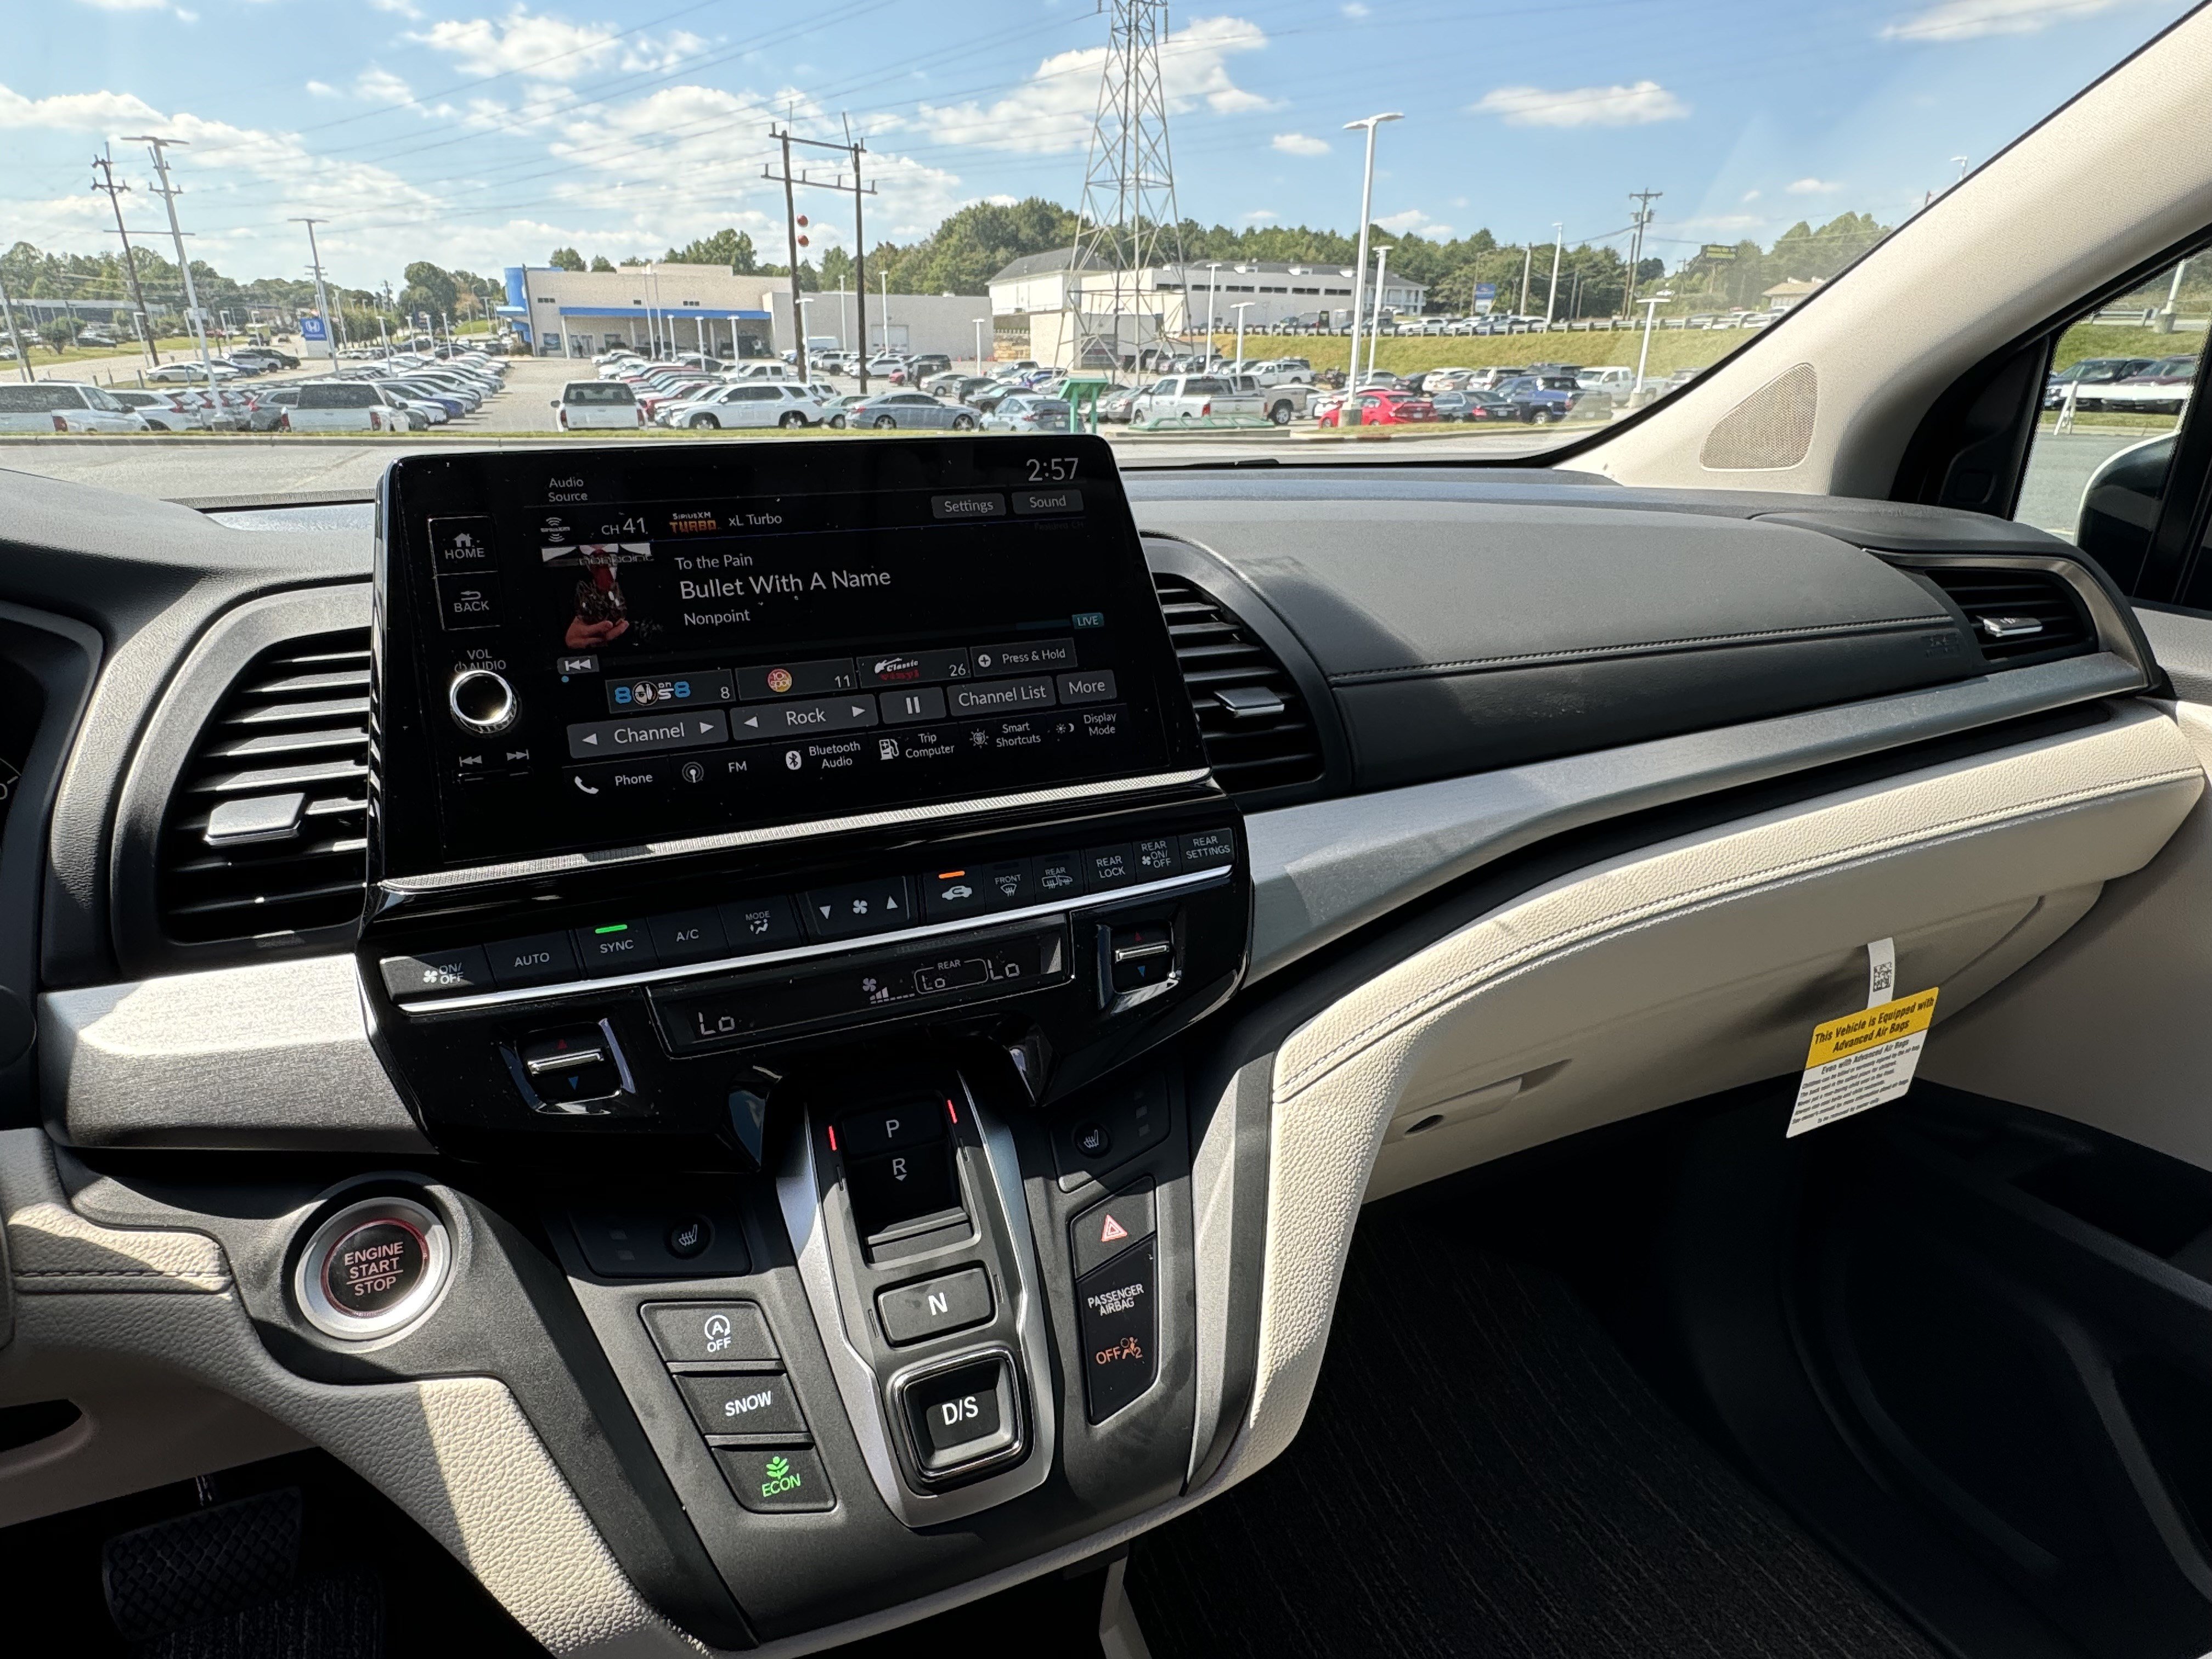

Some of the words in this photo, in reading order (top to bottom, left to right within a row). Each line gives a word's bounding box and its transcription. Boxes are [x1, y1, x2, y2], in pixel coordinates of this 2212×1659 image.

[1026, 458, 1079, 482] 2:57
[549, 477, 584, 488] Audio
[549, 491, 588, 501] Source
[1029, 494, 1066, 509] Sound
[944, 498, 994, 514] Settings
[601, 524, 620, 535] CH
[622, 517, 646, 534] 41
[669, 520, 716, 533] TURBO
[729, 515, 743, 527] xL
[746, 513, 782, 525] Turbo
[445, 548, 485, 560] HOME
[675, 556, 693, 570] To
[696, 555, 719, 568] the
[723, 554, 753, 567] Pain
[680, 578, 743, 600] Bullet
[749, 574, 803, 594] With
[810, 571, 827, 590] A
[832, 568, 891, 589] Name
[454, 600, 489, 613] BACK
[684, 608, 751, 626] Nonpoint
[1076, 615, 1099, 627] LIVE
[466, 649, 492, 659] VOL
[1002, 651, 1029, 664] Press
[1031, 650, 1039, 662] &
[1042, 647, 1065, 661] Hold
[469, 659, 506, 670] AUDIO
[949, 663, 967, 677] 26
[834, 675, 850, 689] 11
[1068, 678, 1106, 696] More
[720, 686, 730, 699] 8
[958, 687, 1018, 708] Channel
[1021, 684, 1047, 701] List
[786, 706, 826, 726] Rock
[1084, 712, 1116, 726] Display
[613, 723, 685, 745] Channel
[1002, 721, 1030, 734] Smart
[1088, 724, 1116, 736] Mode
[918, 732, 937, 746] Trip
[996, 733, 1041, 748] Shortcuts
[808, 741, 861, 757] Bluetooth
[905, 743, 955, 759] Computer
[728, 760, 748, 773] FM
[822, 756, 853, 769] Audio
[614, 772, 653, 786] Phone
[1141, 840, 1167, 852] REAR
[1193, 836, 1219, 848] REAR
[1186, 845, 1231, 860] SETTINGS
[1096, 855, 1122, 867] REAR
[1153, 857, 1172, 869] OFF
[1045, 866, 1066, 876] REAR
[1099, 866, 1126, 878] LOCK
[994, 873, 1022, 885] FRONT
[745, 910, 771, 922] MODE
[676, 929, 699, 943] A/C
[599, 939, 634, 954] SYNC
[514, 952, 550, 968] AUTO
[937, 958, 962, 971] REAR
[988, 959, 1021, 981] Lo
[439, 971, 465, 985] OFF
[698, 1011, 736, 1036] Lo
[1815, 1030, 1833, 1045] This
[1836, 1019, 1866, 1039] Vehicle
[1877, 1001, 1917, 1024] Equipped
[1917, 996, 1934, 1012] with
[1832, 1029, 1875, 1053] Advanced
[1874, 1025, 1888, 1039] Air
[1889, 1019, 1910, 1034] Bags
[885, 1119, 901, 1138] P
[891, 1157, 907, 1176] R
[345, 1242, 403, 1266] ENGINE
[350, 1257, 399, 1279] START
[355, 1276, 396, 1296] STOP
[1087, 1283, 1144, 1309] PASSENGER
[928, 1291, 949, 1317] N
[1099, 1296, 1135, 1317] AIRBAG
[706, 1337, 732, 1353] OFF
[1095, 1346, 1122, 1365] OFF
[725, 1390, 772, 1417] SNOW
[941, 1395, 980, 1426] D/S
[761, 1473, 802, 1497] ECON
